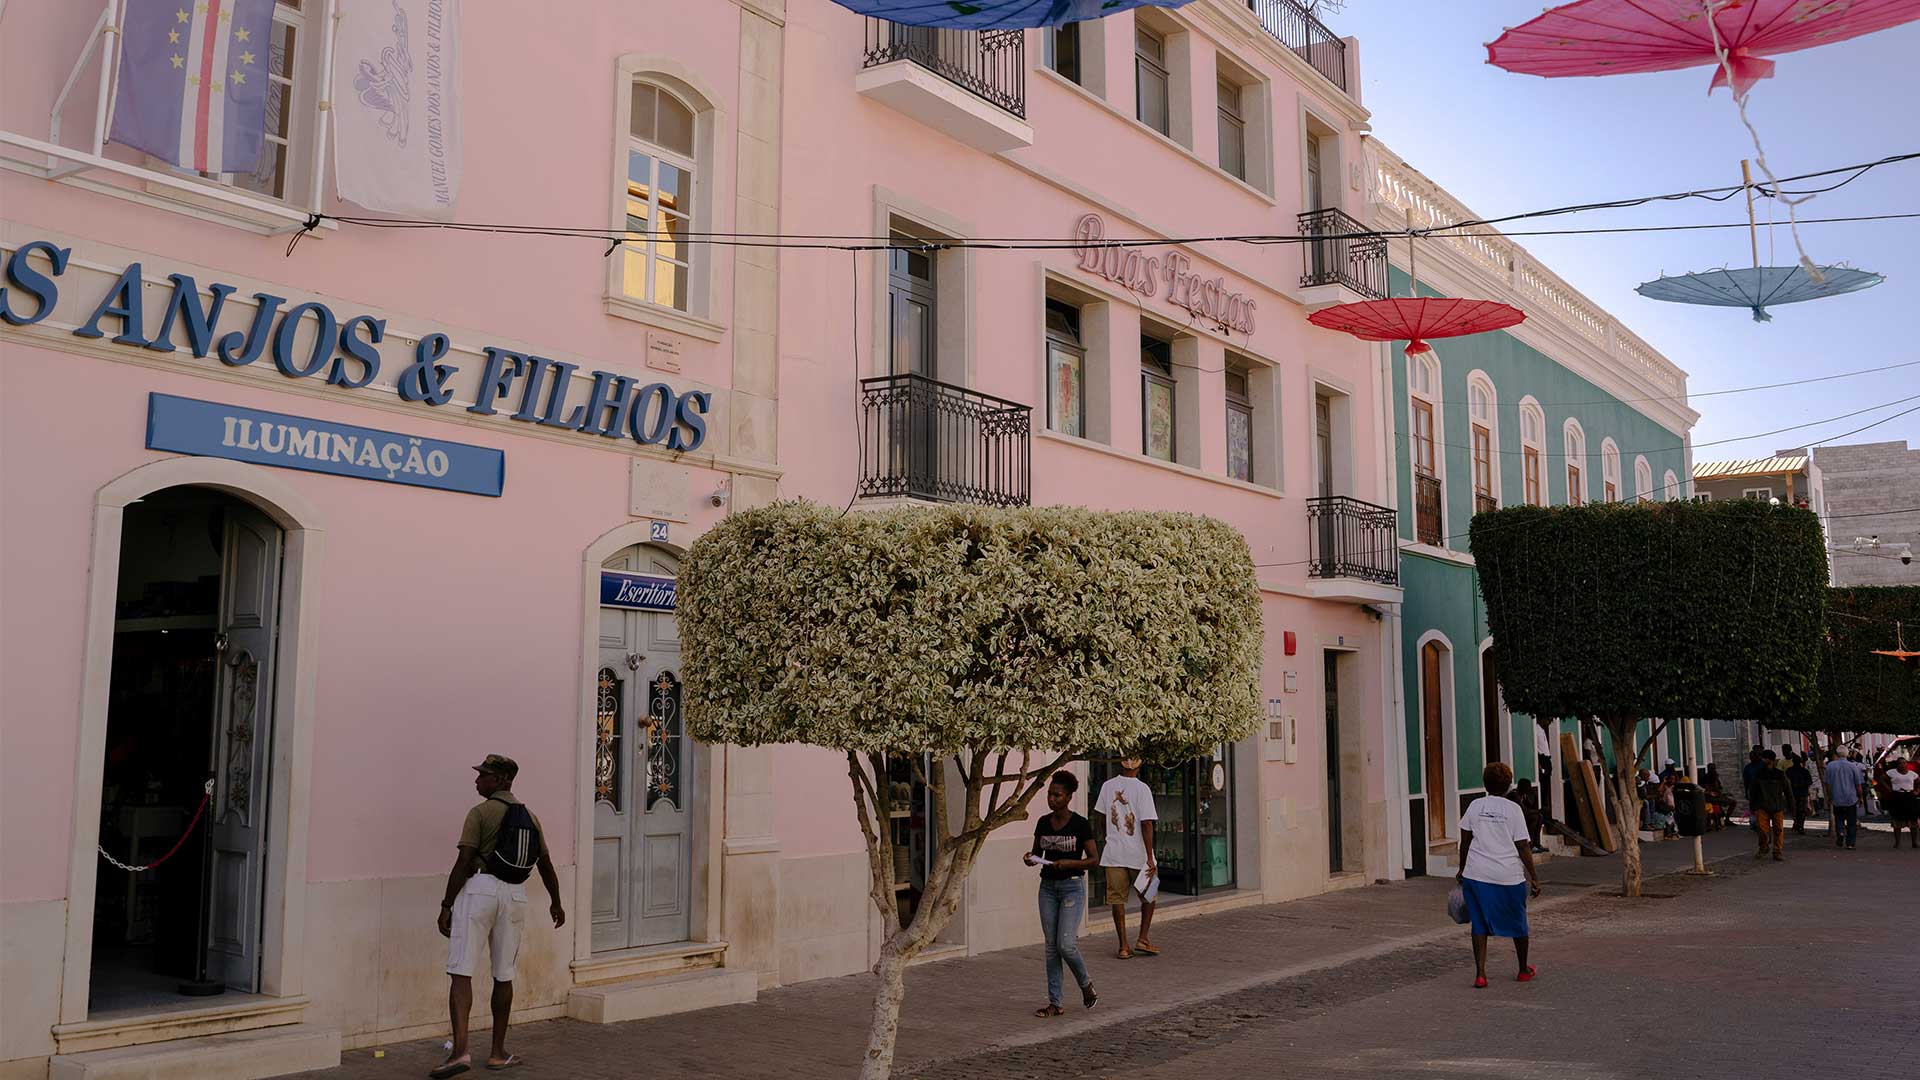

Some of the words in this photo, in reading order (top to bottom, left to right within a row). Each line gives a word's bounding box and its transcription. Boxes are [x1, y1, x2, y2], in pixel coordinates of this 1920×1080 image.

[427, 53, 441, 90] ANJOS
[427, 90, 441, 115] DOS
[428, 115, 443, 158] GOMES
[431, 159, 449, 203] MANUEL
[1074, 213, 1160, 298] Boas
[1164, 250, 1257, 335] Festas
[72, 262, 388, 389] ANJOS
[398, 332, 459, 407] &
[466, 346, 713, 452] FILHOS
[222, 416, 449, 479] ILUMINAÇÃO
[652, 524, 667, 539] 24
